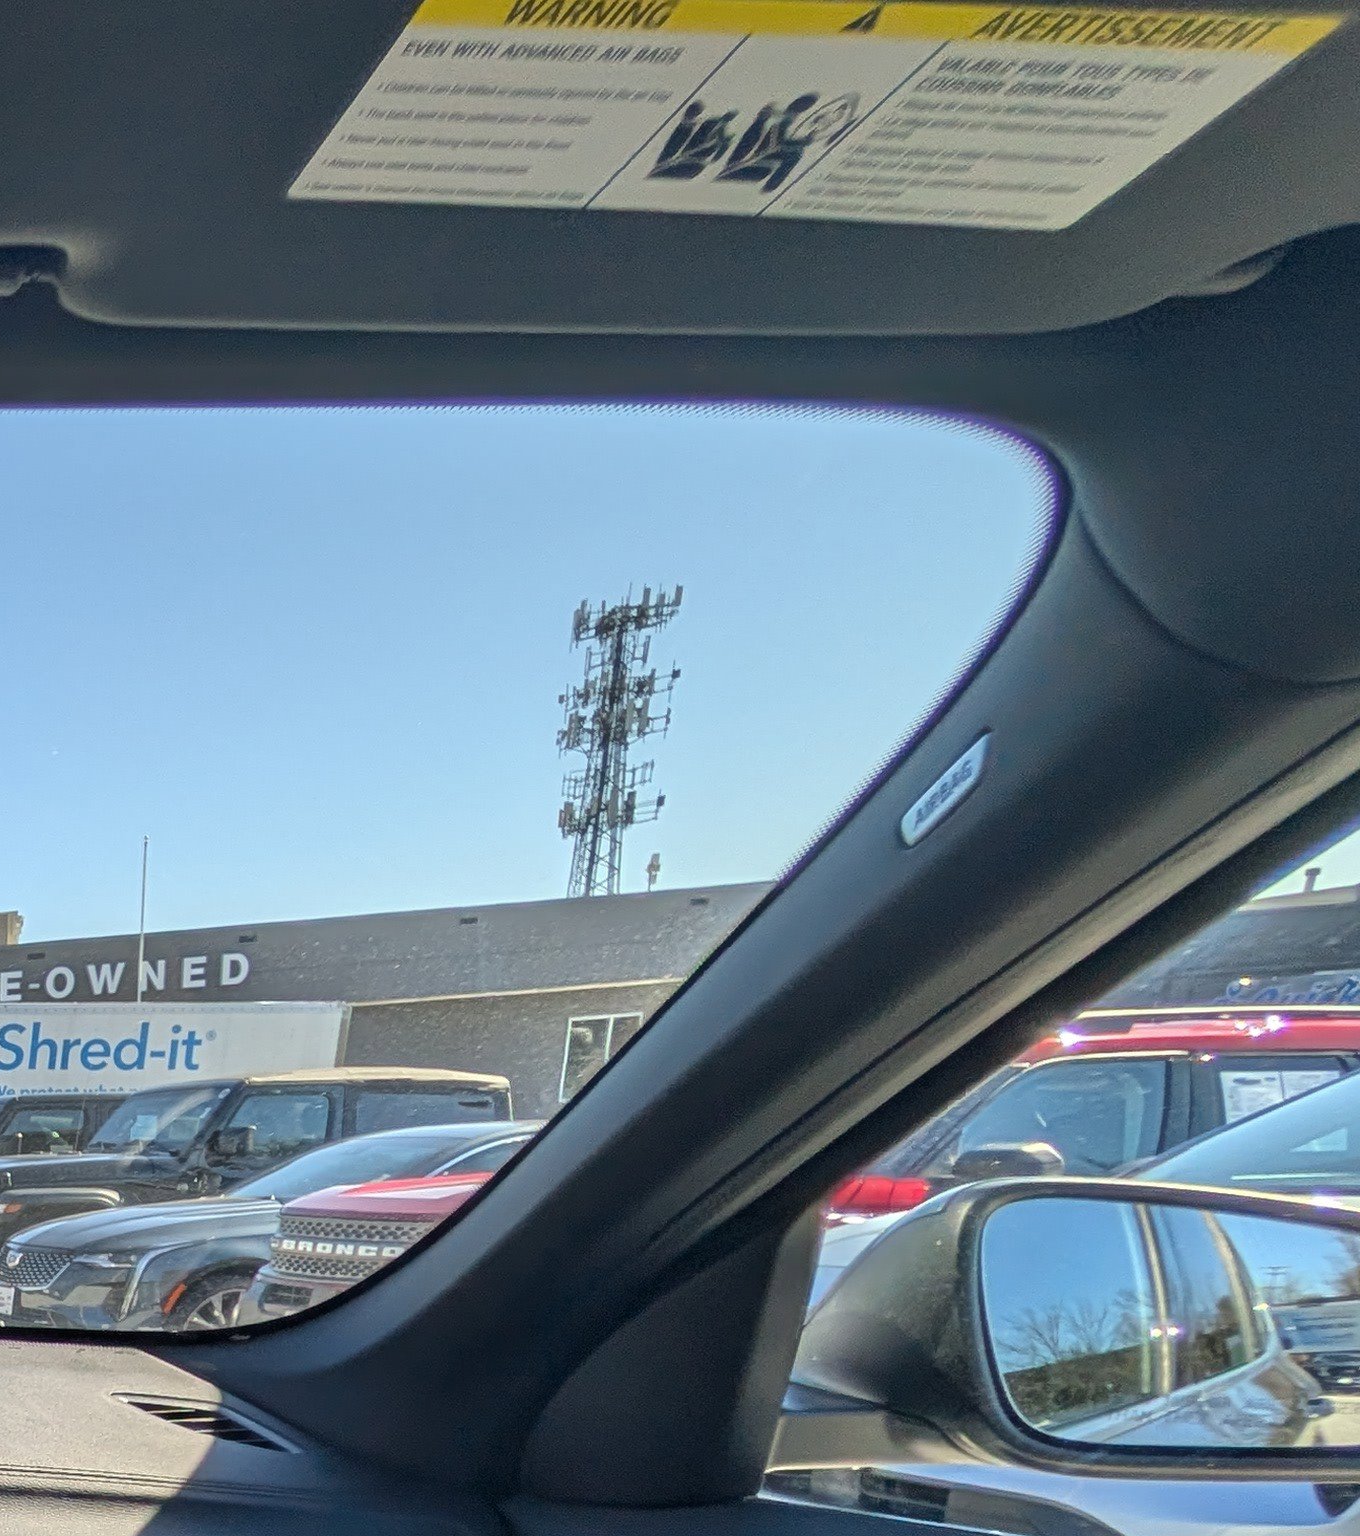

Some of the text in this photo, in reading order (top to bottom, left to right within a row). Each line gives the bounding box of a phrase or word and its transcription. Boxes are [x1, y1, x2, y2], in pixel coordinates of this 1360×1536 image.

[504, 0, 677, 29] WARNING
[971, 9, 1284, 49] AVERTISSEMENT
[401, 38, 452, 58] EVEN
[451, 40, 502, 60] WITH
[498, 42, 597, 62] ADVANCED
[594, 46, 630, 63] AIR
[281, 1239, 405, 1257] BRONCO
